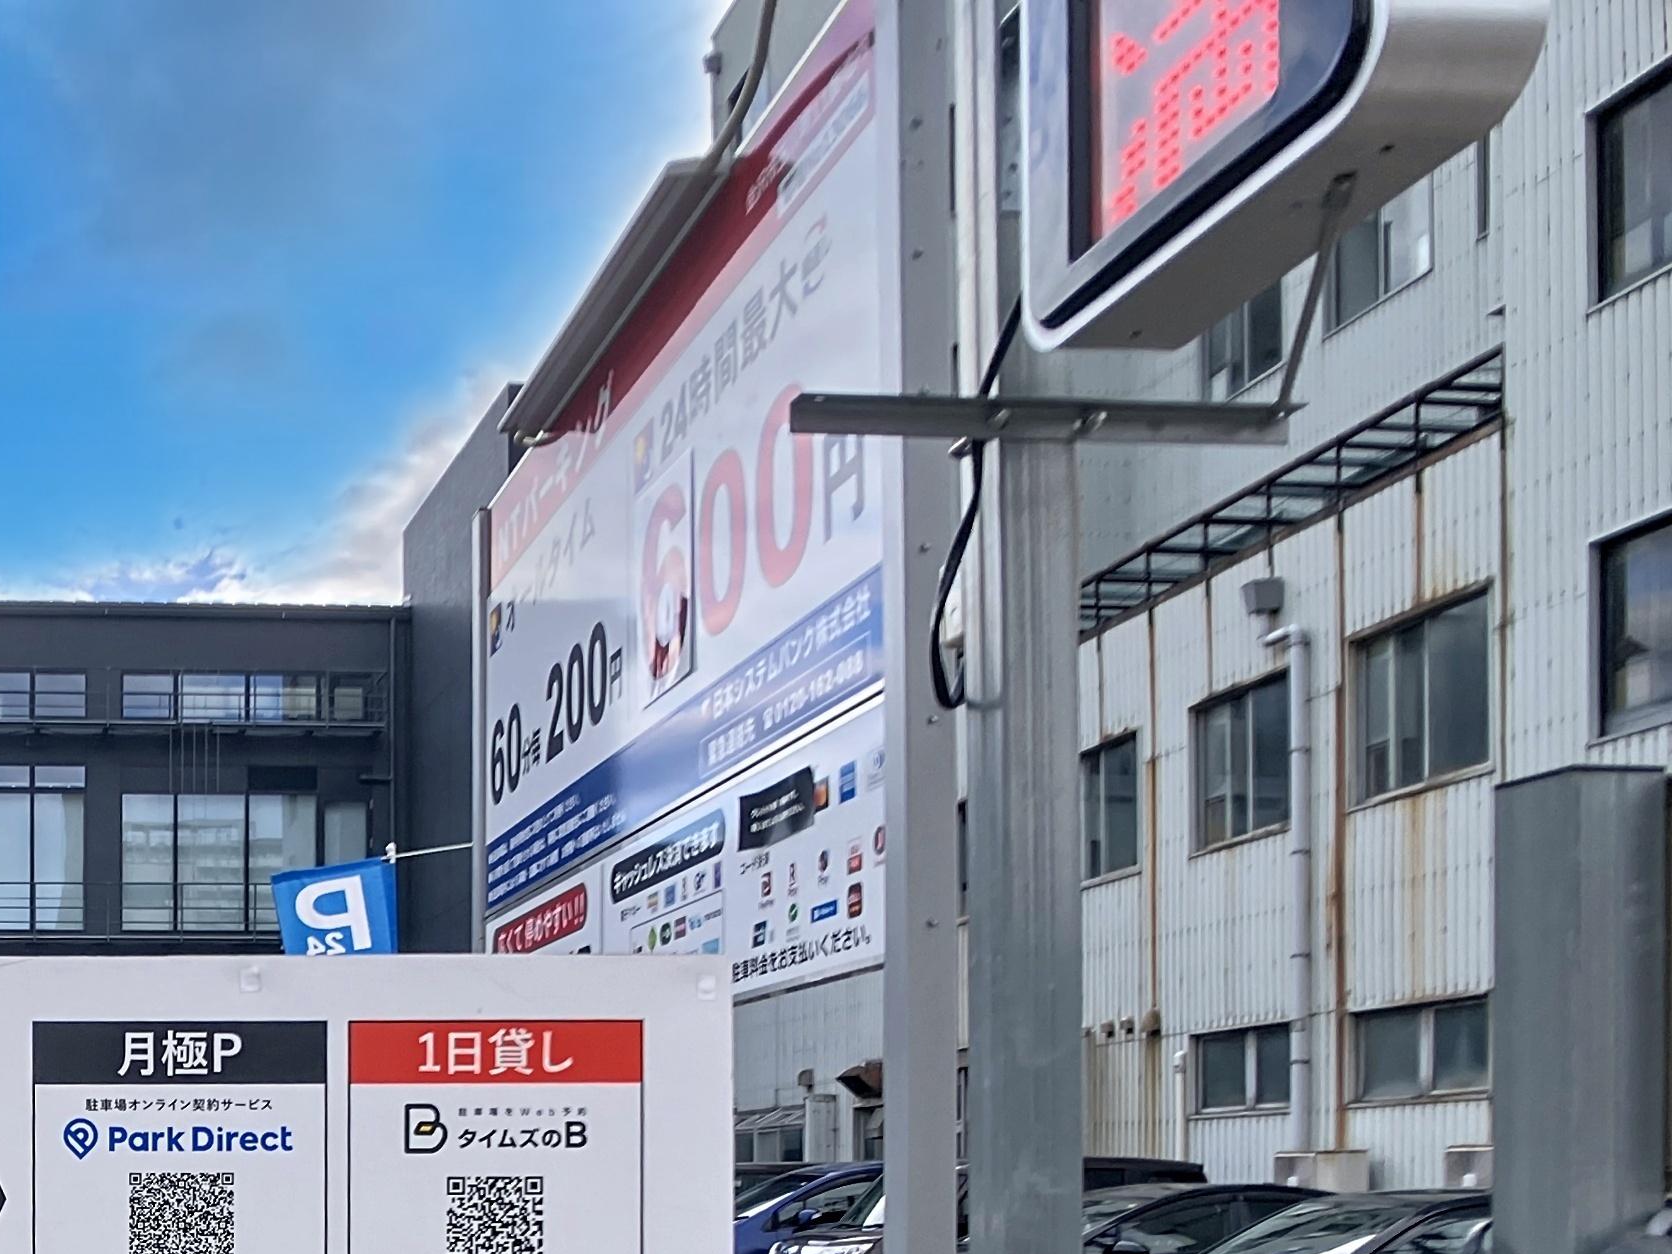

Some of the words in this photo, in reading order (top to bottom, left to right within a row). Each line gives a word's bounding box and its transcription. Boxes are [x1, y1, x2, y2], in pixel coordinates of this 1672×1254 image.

[117, 1029, 242, 1077] 月極P
[418, 1028, 575, 1076] 1日貸し
[85, 1098, 273, 1112] 駐車場オンライン契約サービス
[108, 1126, 185, 1152] Park
[191, 1126, 294, 1152] Direct
[457, 1120, 588, 1149] タイムズのB
